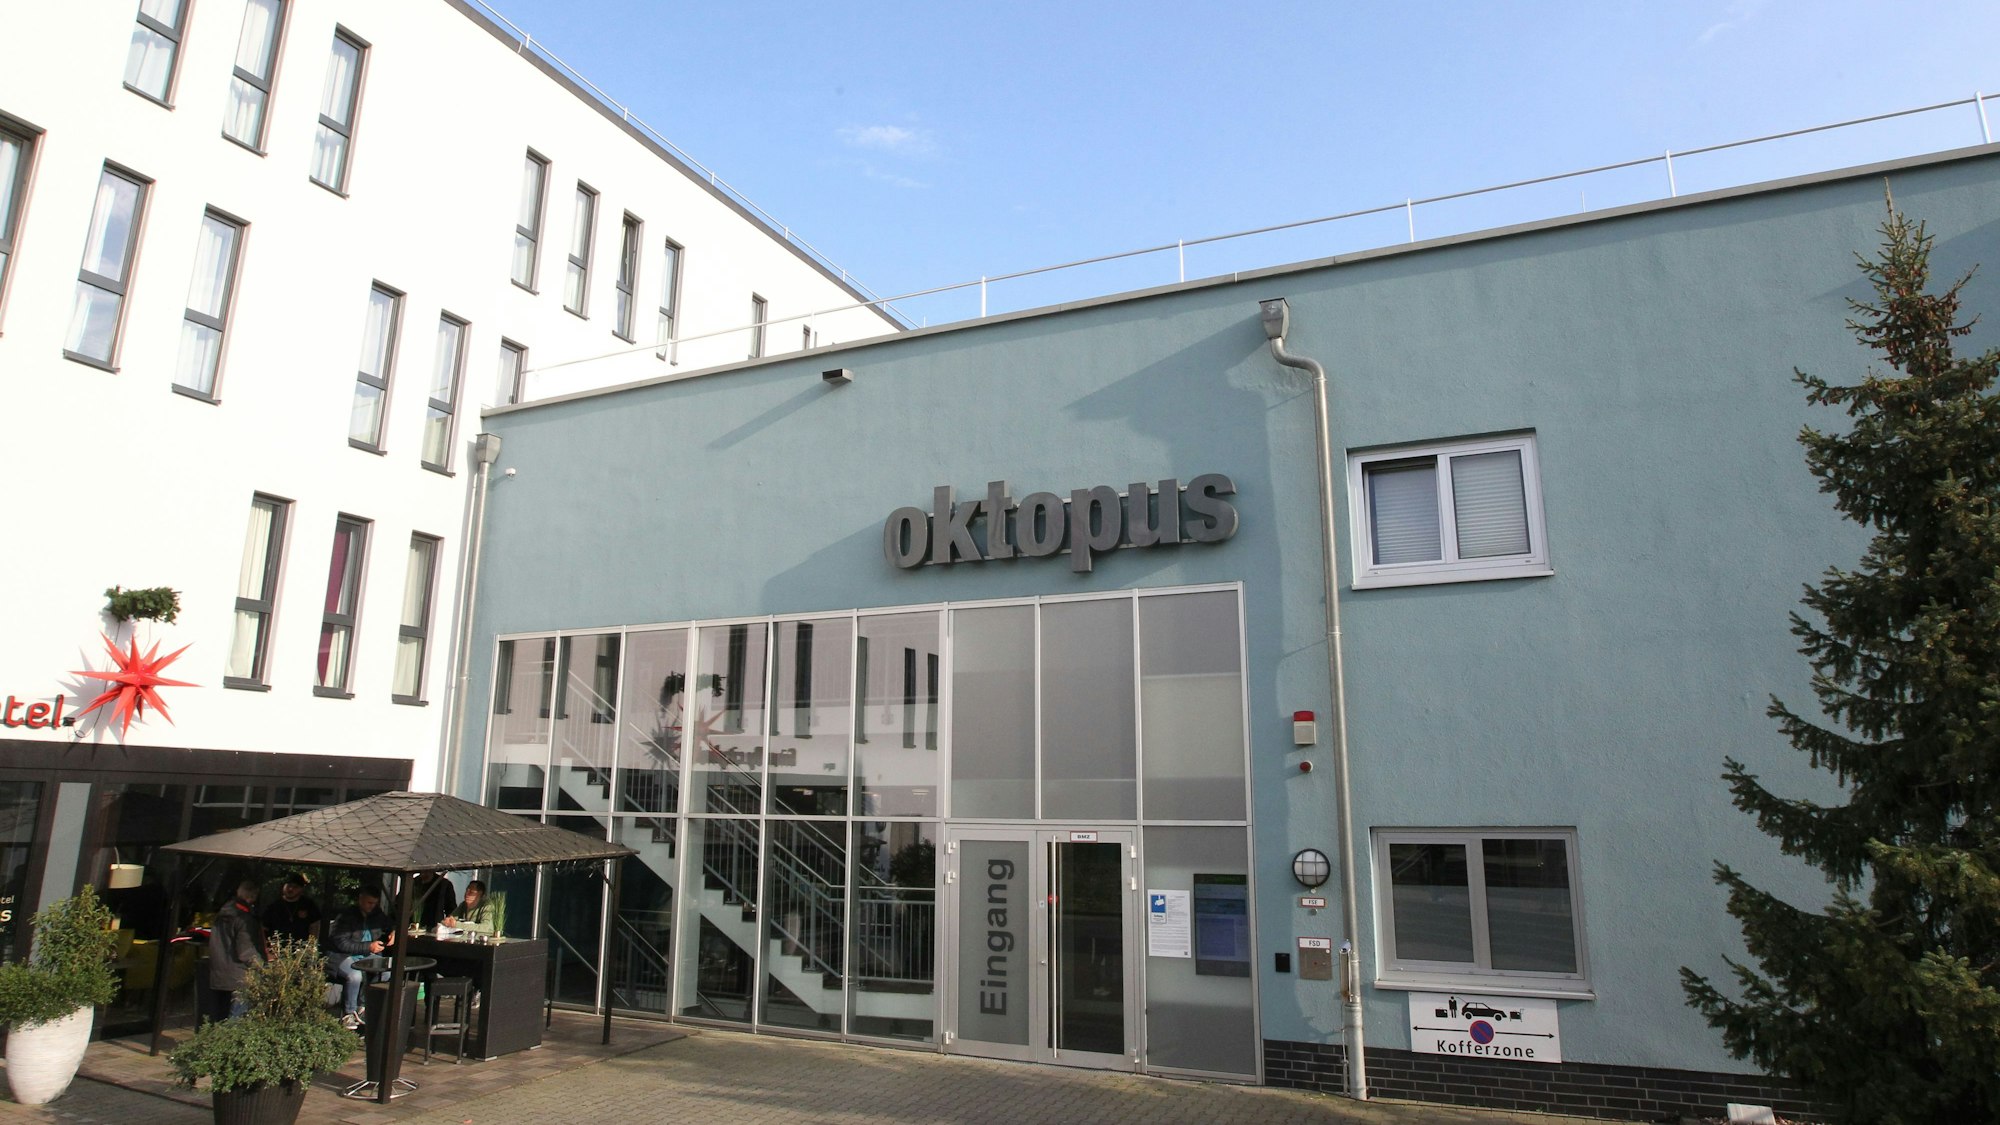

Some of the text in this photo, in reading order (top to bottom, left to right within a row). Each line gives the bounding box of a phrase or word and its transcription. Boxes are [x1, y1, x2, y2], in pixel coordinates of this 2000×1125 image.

[884, 473, 1239, 572] oktopus
[0, 694, 64, 730] tel
[980, 859, 1015, 1015] Eingang
[1437, 1039, 1535, 1058] Kofferzone
